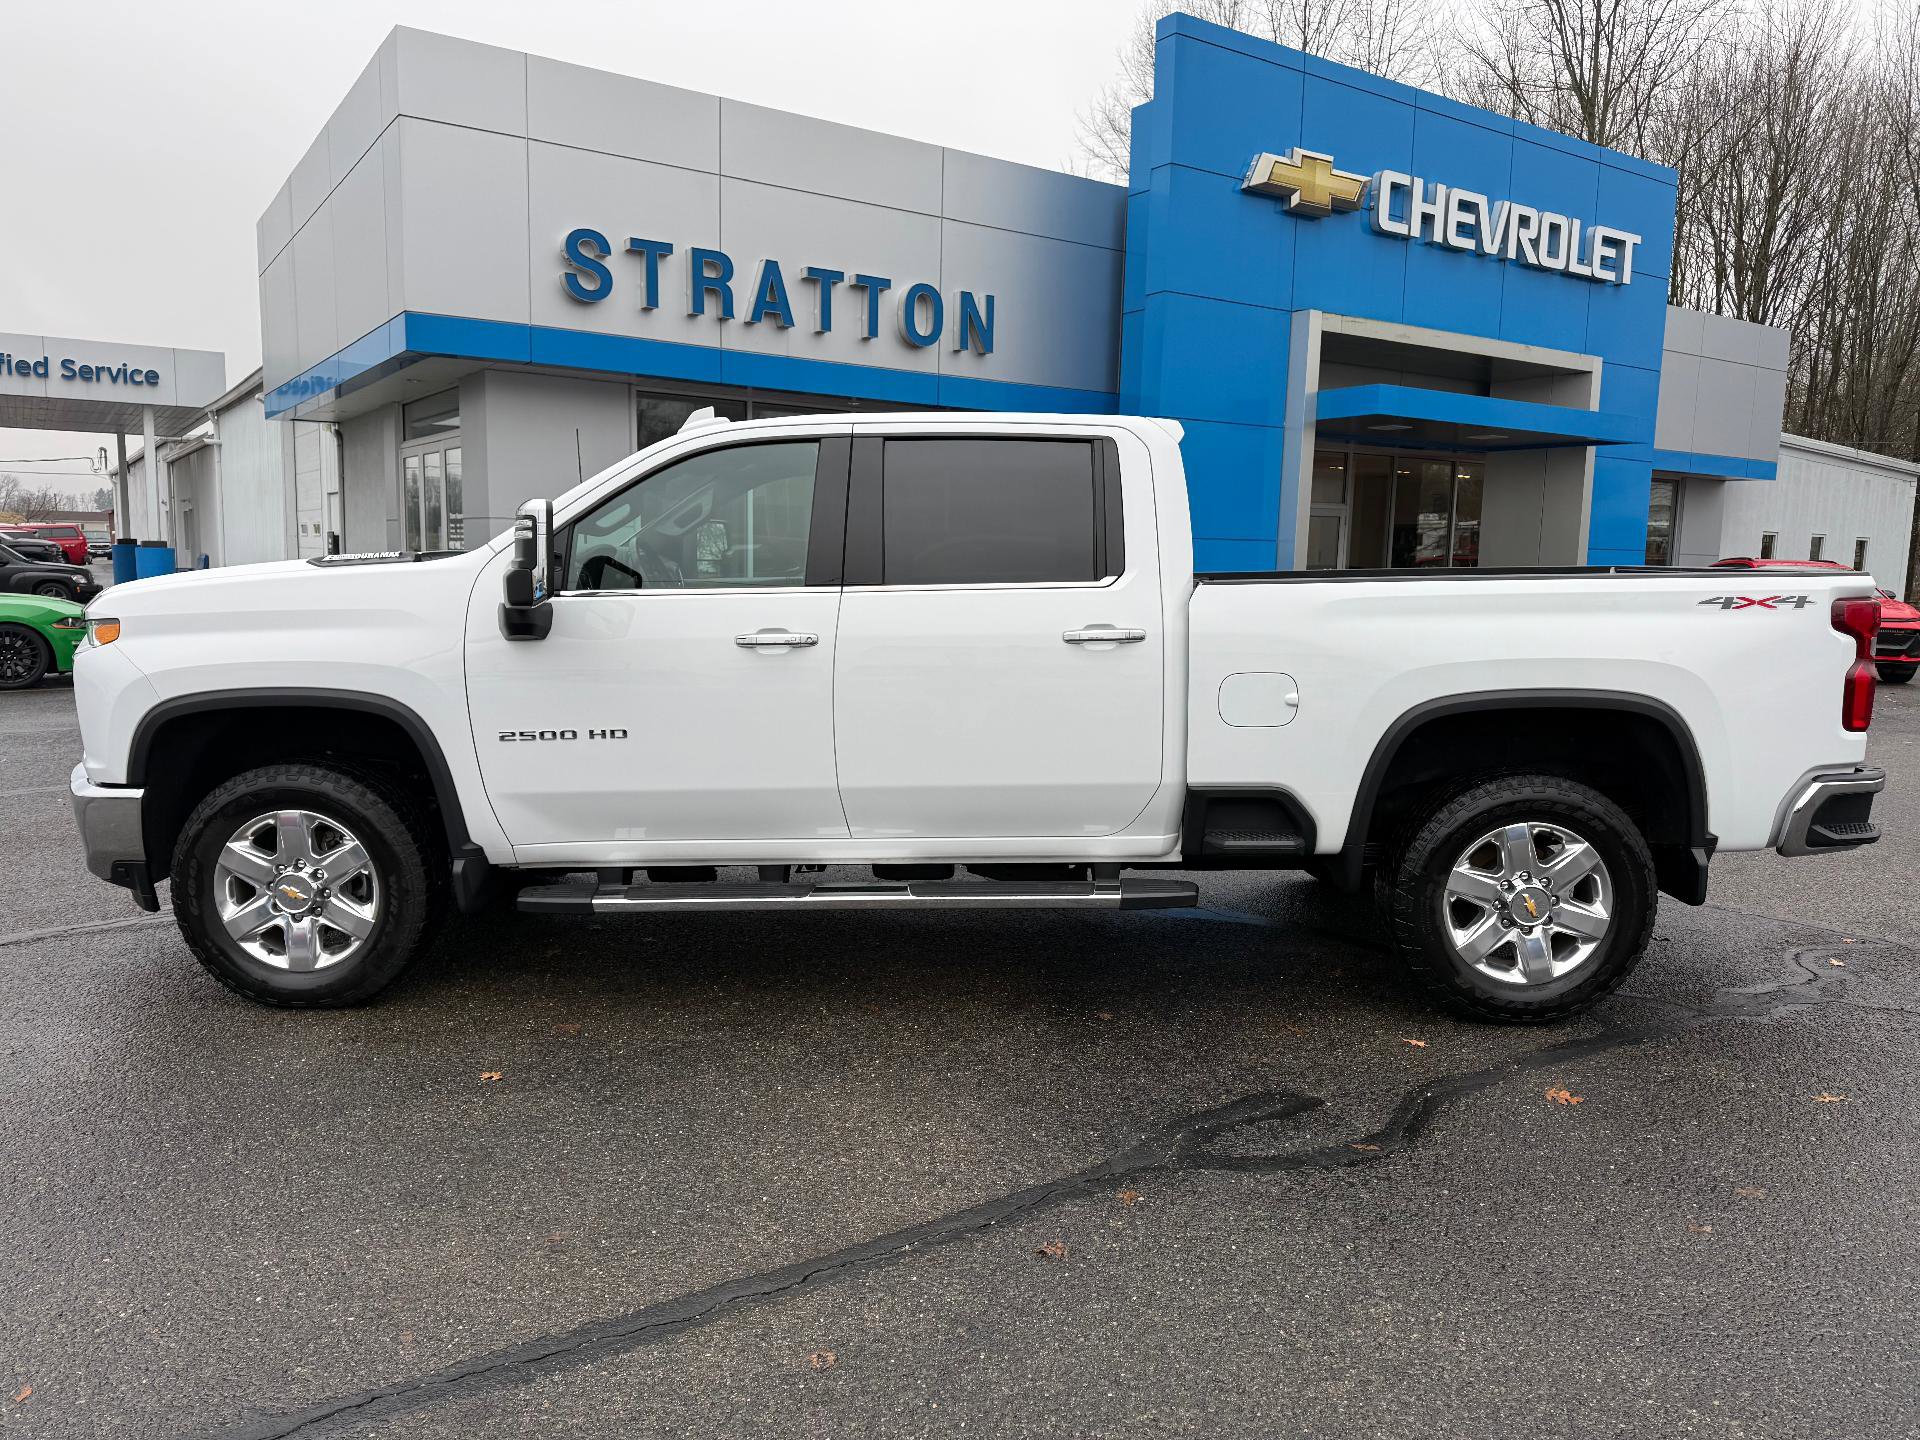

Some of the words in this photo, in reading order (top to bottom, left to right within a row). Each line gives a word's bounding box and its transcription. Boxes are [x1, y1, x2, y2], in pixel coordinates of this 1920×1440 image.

[1370, 169, 1642, 286] CHEVROLET
[559, 227, 996, 355] STRATTON
[60, 358, 160, 386] Service
[498, 729, 578, 742] 2500
[588, 729, 628, 740] HD
